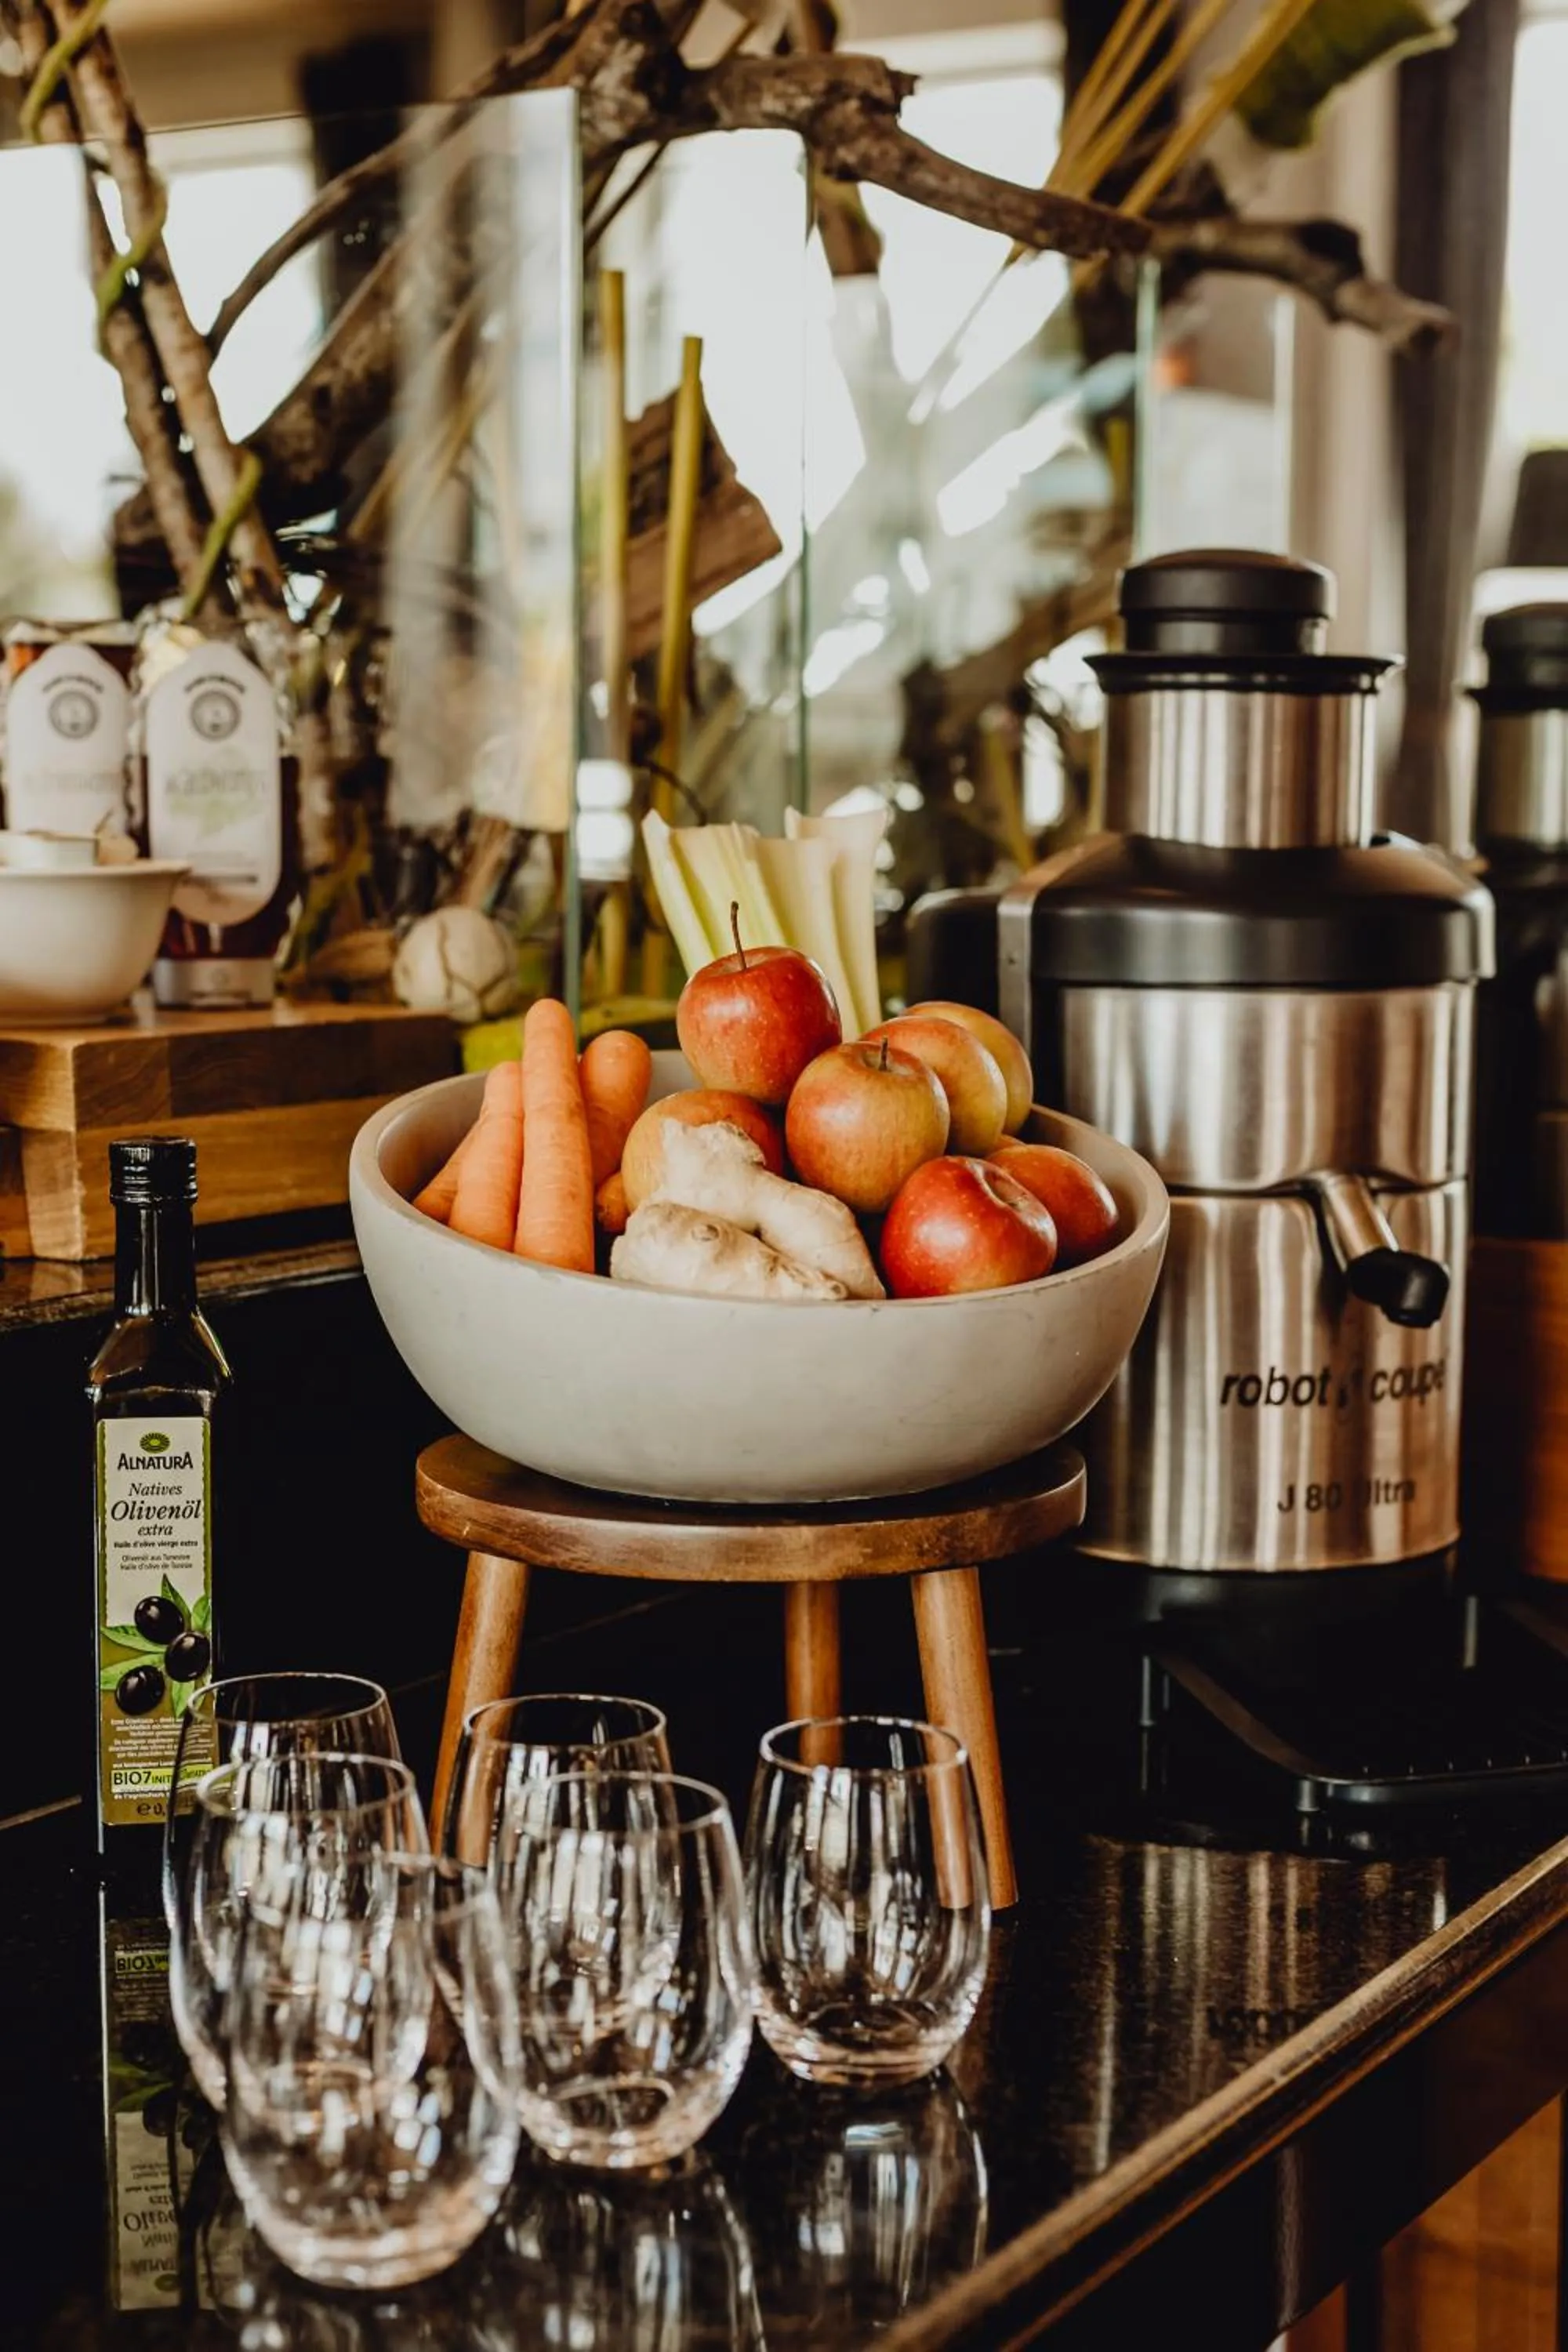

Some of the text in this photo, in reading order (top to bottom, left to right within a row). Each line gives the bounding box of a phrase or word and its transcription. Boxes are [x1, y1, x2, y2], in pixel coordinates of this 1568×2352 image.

[1220, 1366, 1332, 1408] robot
[118, 1451, 194, 1471] ALNATURA
[128, 1482, 183, 1497] Natives
[1277, 1484, 1296, 1512] J
[1305, 1483, 1342, 1511] 80
[111, 1499, 201, 1521] Olivenöl
[137, 1524, 172, 1536] extra
